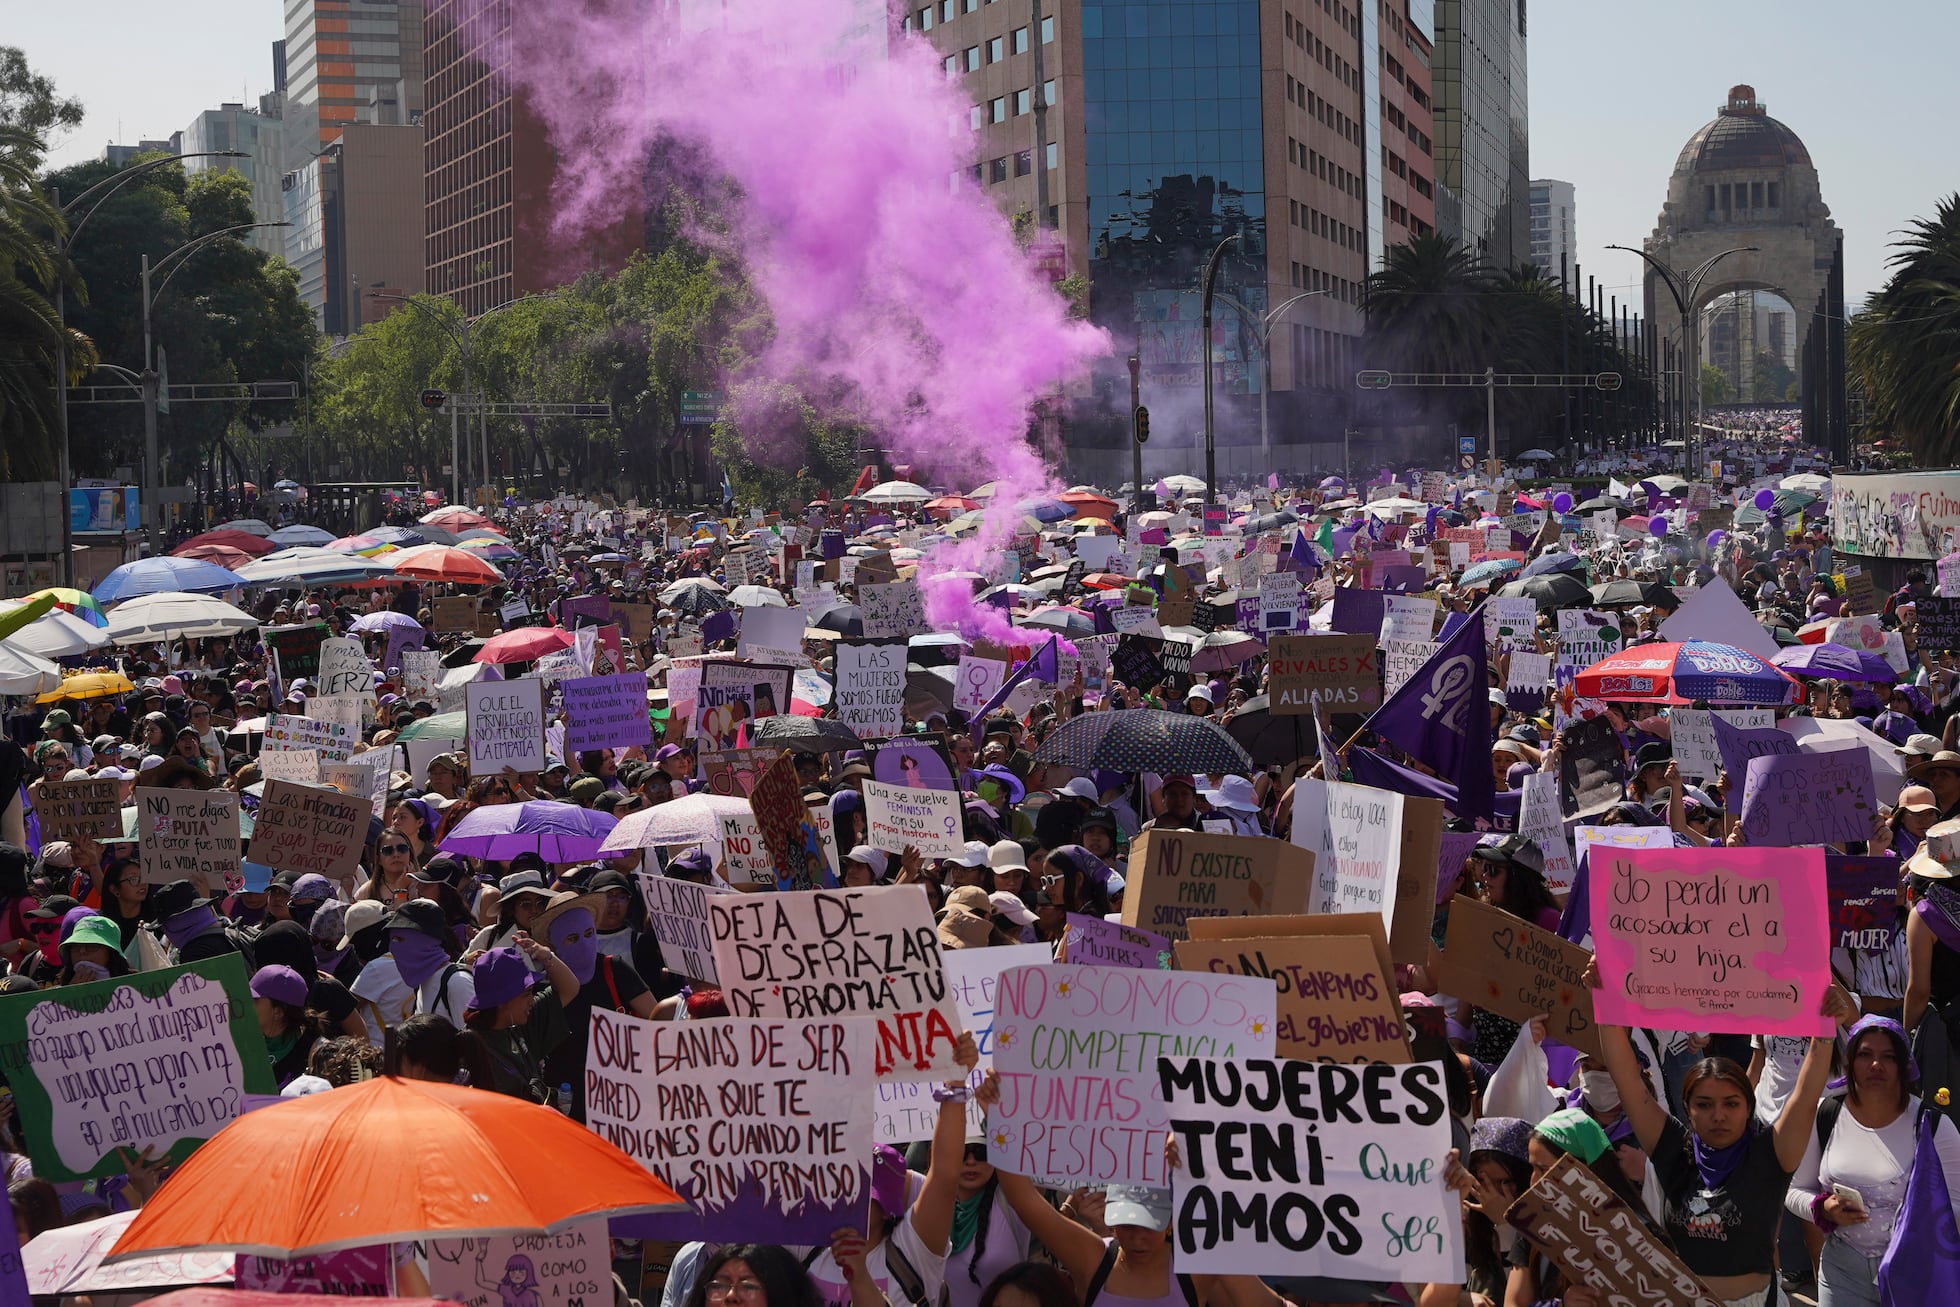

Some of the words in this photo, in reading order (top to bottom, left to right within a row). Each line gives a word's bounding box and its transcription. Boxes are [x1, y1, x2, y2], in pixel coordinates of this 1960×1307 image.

[1565, 611, 1577, 629] Si
[858, 651, 890, 669] LAS
[1161, 641, 1189, 657] MIEDO
[1272, 657, 1350, 676] RIVALES
[319, 671, 375, 696] UERZ
[848, 671, 901, 688] MUJERES
[480, 696, 508, 712] QUE
[510, 695, 524, 710] EL
[697, 686, 724, 708] NO
[840, 689, 874, 707] SOMOS
[876, 688, 902, 706] FUEGO
[1279, 686, 1360, 706] ALIADAS
[269, 712, 292, 729] Hey
[476, 711, 534, 728] PRIVILEGIO
[847, 707, 897, 724] ARDEMOS
[1673, 710, 1690, 727] NO
[1749, 713, 1769, 727] QUE
[475, 727, 493, 741] NO
[496, 728, 508, 740] TE
[510, 725, 539, 739] NUBLE
[1674, 732, 1688, 744] ES
[1692, 733, 1704, 744] EL
[475, 743, 493, 761] LA
[1676, 747, 1690, 760] TE
[1750, 762, 1808, 792] Somos
[38, 784, 62, 800] QUE
[62, 783, 81, 800] SER
[268, 782, 299, 809] Las
[303, 794, 359, 822] infancias
[868, 783, 889, 799] Una
[893, 791, 908, 803] se
[913, 792, 949, 806] vuelve
[53, 803, 67, 817] NO
[147, 797, 170, 816] NO
[176, 804, 196, 819] me
[200, 800, 231, 826] digas
[886, 801, 933, 816] FEMINISTA
[1324, 786, 1337, 818] Ni
[1341, 795, 1365, 834] estoy
[59, 823, 73, 838] LA
[74, 821, 99, 837] VIDA
[172, 820, 209, 836] PUTA
[262, 807, 285, 823] no
[288, 811, 308, 830] se
[312, 816, 356, 840] tocan
[724, 819, 742, 835] Mi
[890, 814, 908, 827] con
[909, 818, 925, 829] su
[901, 827, 941, 840] historia
[145, 833, 157, 849] el
[163, 834, 191, 849] error
[194, 838, 213, 856] fue
[216, 838, 237, 849] TUYO
[266, 845, 284, 865] 5
[311, 837, 347, 858] tenía
[726, 836, 752, 856] NO
[872, 832, 886, 847] No
[915, 838, 952, 854] SOLA
[1322, 828, 1334, 852] Ni
[1338, 835, 1358, 860] estoy
[160, 855, 171, 871] la
[174, 856, 199, 872] VIDA
[201, 861, 212, 872] es
[730, 856, 744, 869] de
[1157, 838, 1182, 877] NO
[1190, 851, 1253, 881] EXISTES
[1178, 881, 1217, 905] PARA
[1343, 883, 1367, 905] porque
[1613, 860, 1651, 905] Yo
[1665, 874, 1730, 918] perdí
[1738, 882, 1769, 904] un
[711, 899, 797, 941] DEJA
[813, 891, 871, 940] DE
[1609, 912, 1713, 935] acosador
[1728, 912, 1750, 938] el
[1765, 919, 1778, 937] a
[650, 911, 698, 949] RESISTO
[1089, 920, 1110, 938] Por
[1119, 927, 1151, 949] Mas
[1840, 927, 1891, 951] MUJER
[736, 925, 943, 983] DISFRAZAR
[1080, 935, 1144, 969] MUJERES
[1527, 930, 1564, 964] Somos
[684, 948, 706, 982] NO
[1239, 950, 1291, 995] NO
[1650, 946, 1676, 964] su
[1697, 944, 1747, 983] hija.
[731, 986, 768, 1019] DE
[901, 969, 946, 1003] TU
[1534, 973, 1557, 994] que
[1625, 971, 1671, 996] (Gracias
[1674, 981, 1720, 999] hermano
[1723, 985, 1742, 999] por
[1746, 983, 1799, 1004] cuidarme)
[999, 966, 1048, 1020] NO
[1071, 966, 1248, 1028] SOMOS
[1698, 997, 1707, 1008] Te
[1708, 999, 1729, 1010] Amo
[98, 1012, 144, 1052] para
[148, 1005, 217, 1044] lastimar
[46, 1027, 97, 1071] darte
[591, 1012, 643, 1073] QUE
[654, 1023, 740, 1077] GANAS
[751, 1024, 787, 1068] DE
[798, 1023, 850, 1076] SER
[143, 1050, 200, 1099] vida
[202, 1041, 233, 1084] tu
[56, 1061, 147, 1113] tendrían
[586, 1069, 642, 1122] PARED
[657, 1083, 713, 1122] PARA
[717, 1079, 767, 1119] QUE
[774, 1079, 812, 1117] TE
[999, 1071, 1142, 1122] JUNTAS
[1156, 1056, 1447, 1126] MUJERES
[107, 1098, 170, 1149] mujer
[170, 1093, 206, 1132] que
[79, 1119, 104, 1156] de
[592, 1118, 700, 1160] INDIGNES
[708, 1120, 801, 1158] CUANDO
[808, 1120, 849, 1156] ME
[1359, 1141, 1435, 1187] Que
[691, 1159, 736, 1200] SIN
[1561, 1166, 1610, 1209] MI
[1532, 1176, 1578, 1222] SE
[1177, 1191, 1363, 1257] AMOS
[540, 1258, 588, 1279] COMO
[551, 1283, 561, 1298] A
[568, 1280, 600, 1295] LOS
